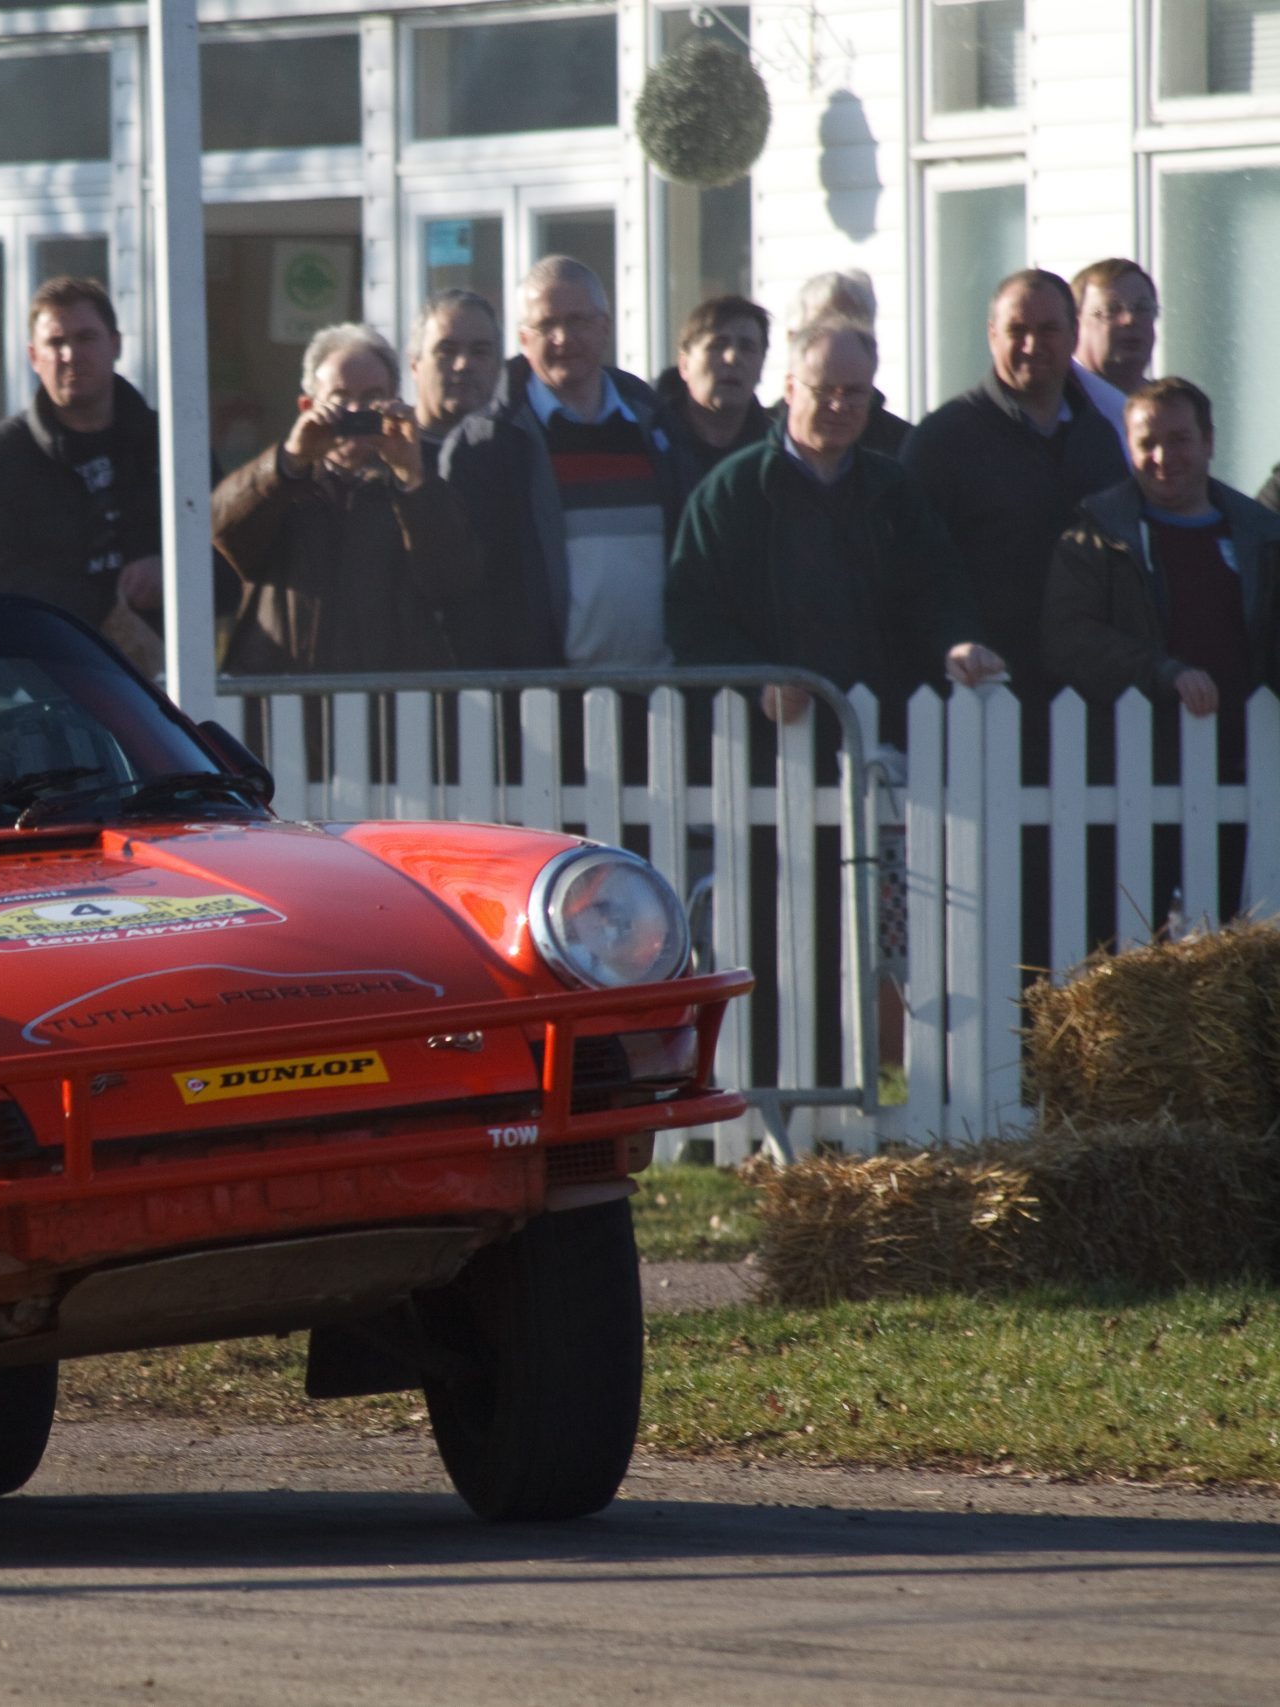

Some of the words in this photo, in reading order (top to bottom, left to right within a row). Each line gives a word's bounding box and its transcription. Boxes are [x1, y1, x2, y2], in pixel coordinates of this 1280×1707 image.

[24, 918, 106, 935] AFRICAN
[110, 910, 176, 926] SAFARI
[175, 898, 249, 916] CLASSIC
[70, 903, 112, 917] 4
[26, 932, 120, 947] Kenya
[126, 915, 246, 938] Airways
[43, 996, 212, 1034] TUTHILL
[219, 978, 417, 1007] PORSCHE
[218, 1057, 375, 1089] DUNLOP
[487, 1125, 539, 1148] TOW
